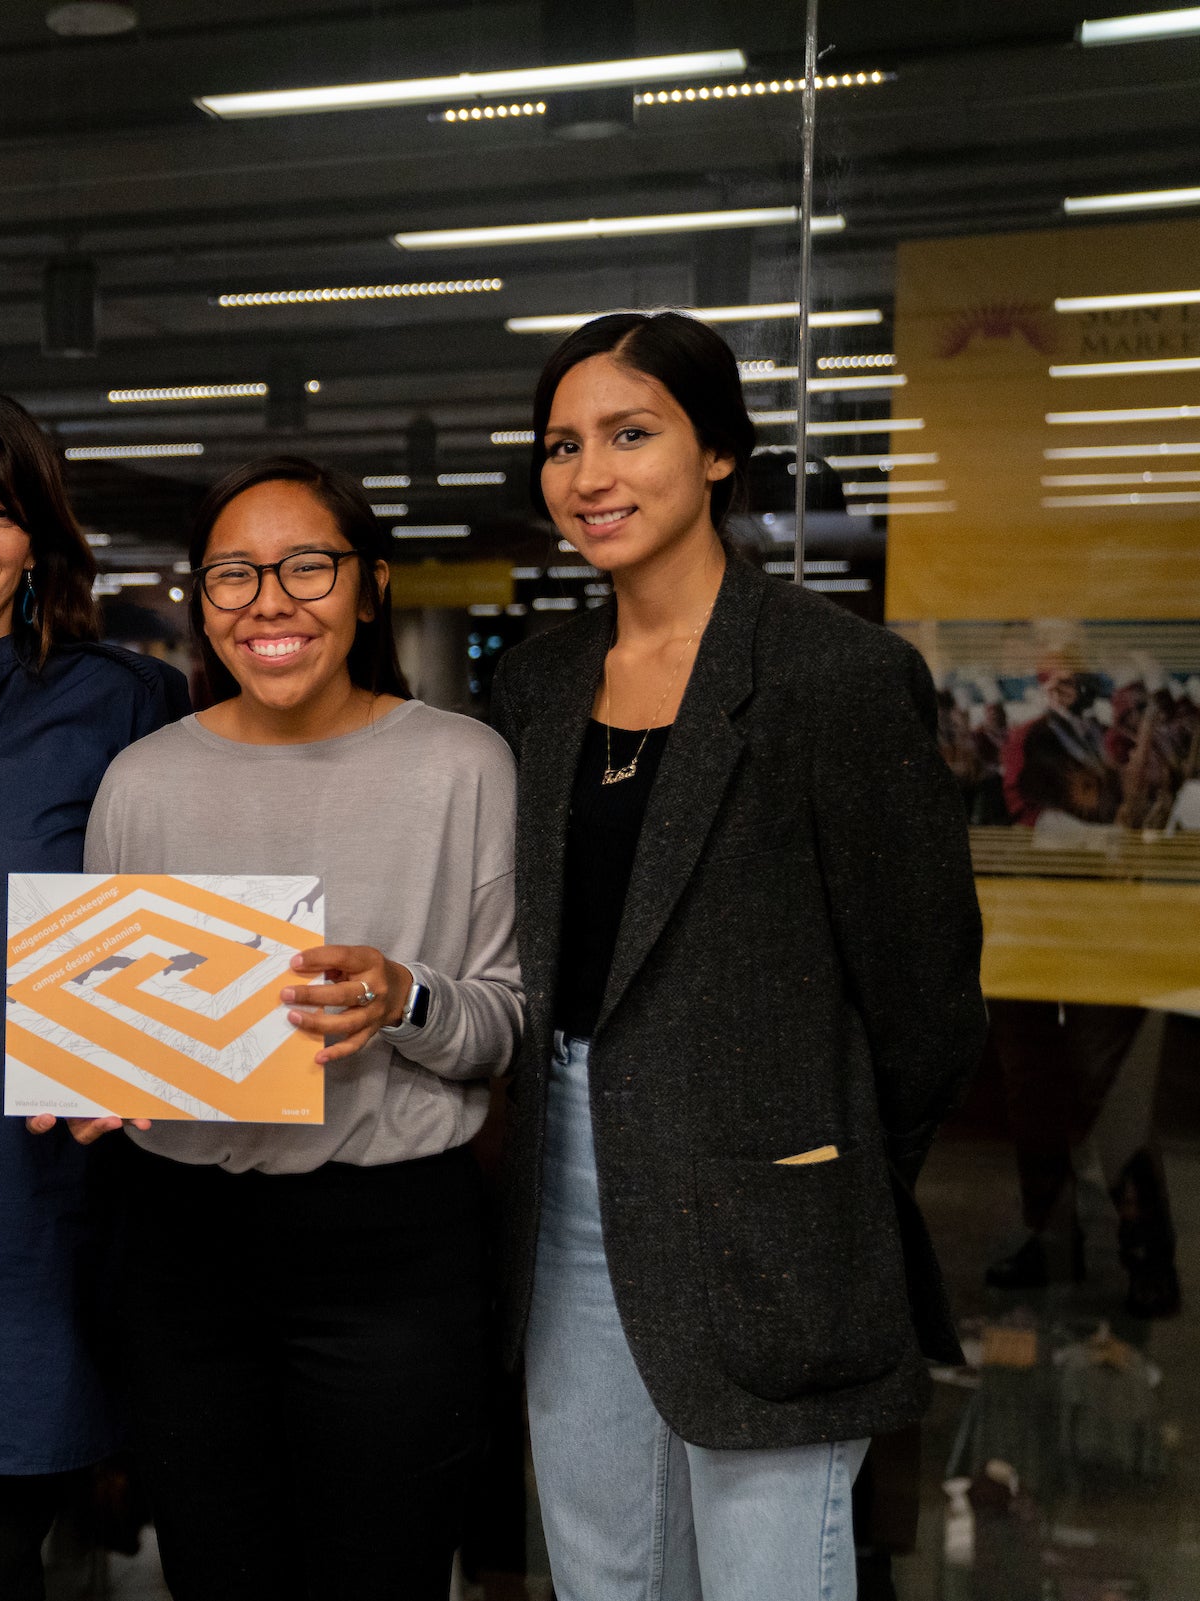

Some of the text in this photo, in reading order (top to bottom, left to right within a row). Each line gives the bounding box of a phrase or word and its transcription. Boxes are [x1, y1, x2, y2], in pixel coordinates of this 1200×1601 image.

[11, 922, 59, 954] indigenous
[32, 970, 65, 992] campus
[65, 950, 95, 972] design
[102, 922, 142, 951] planning
